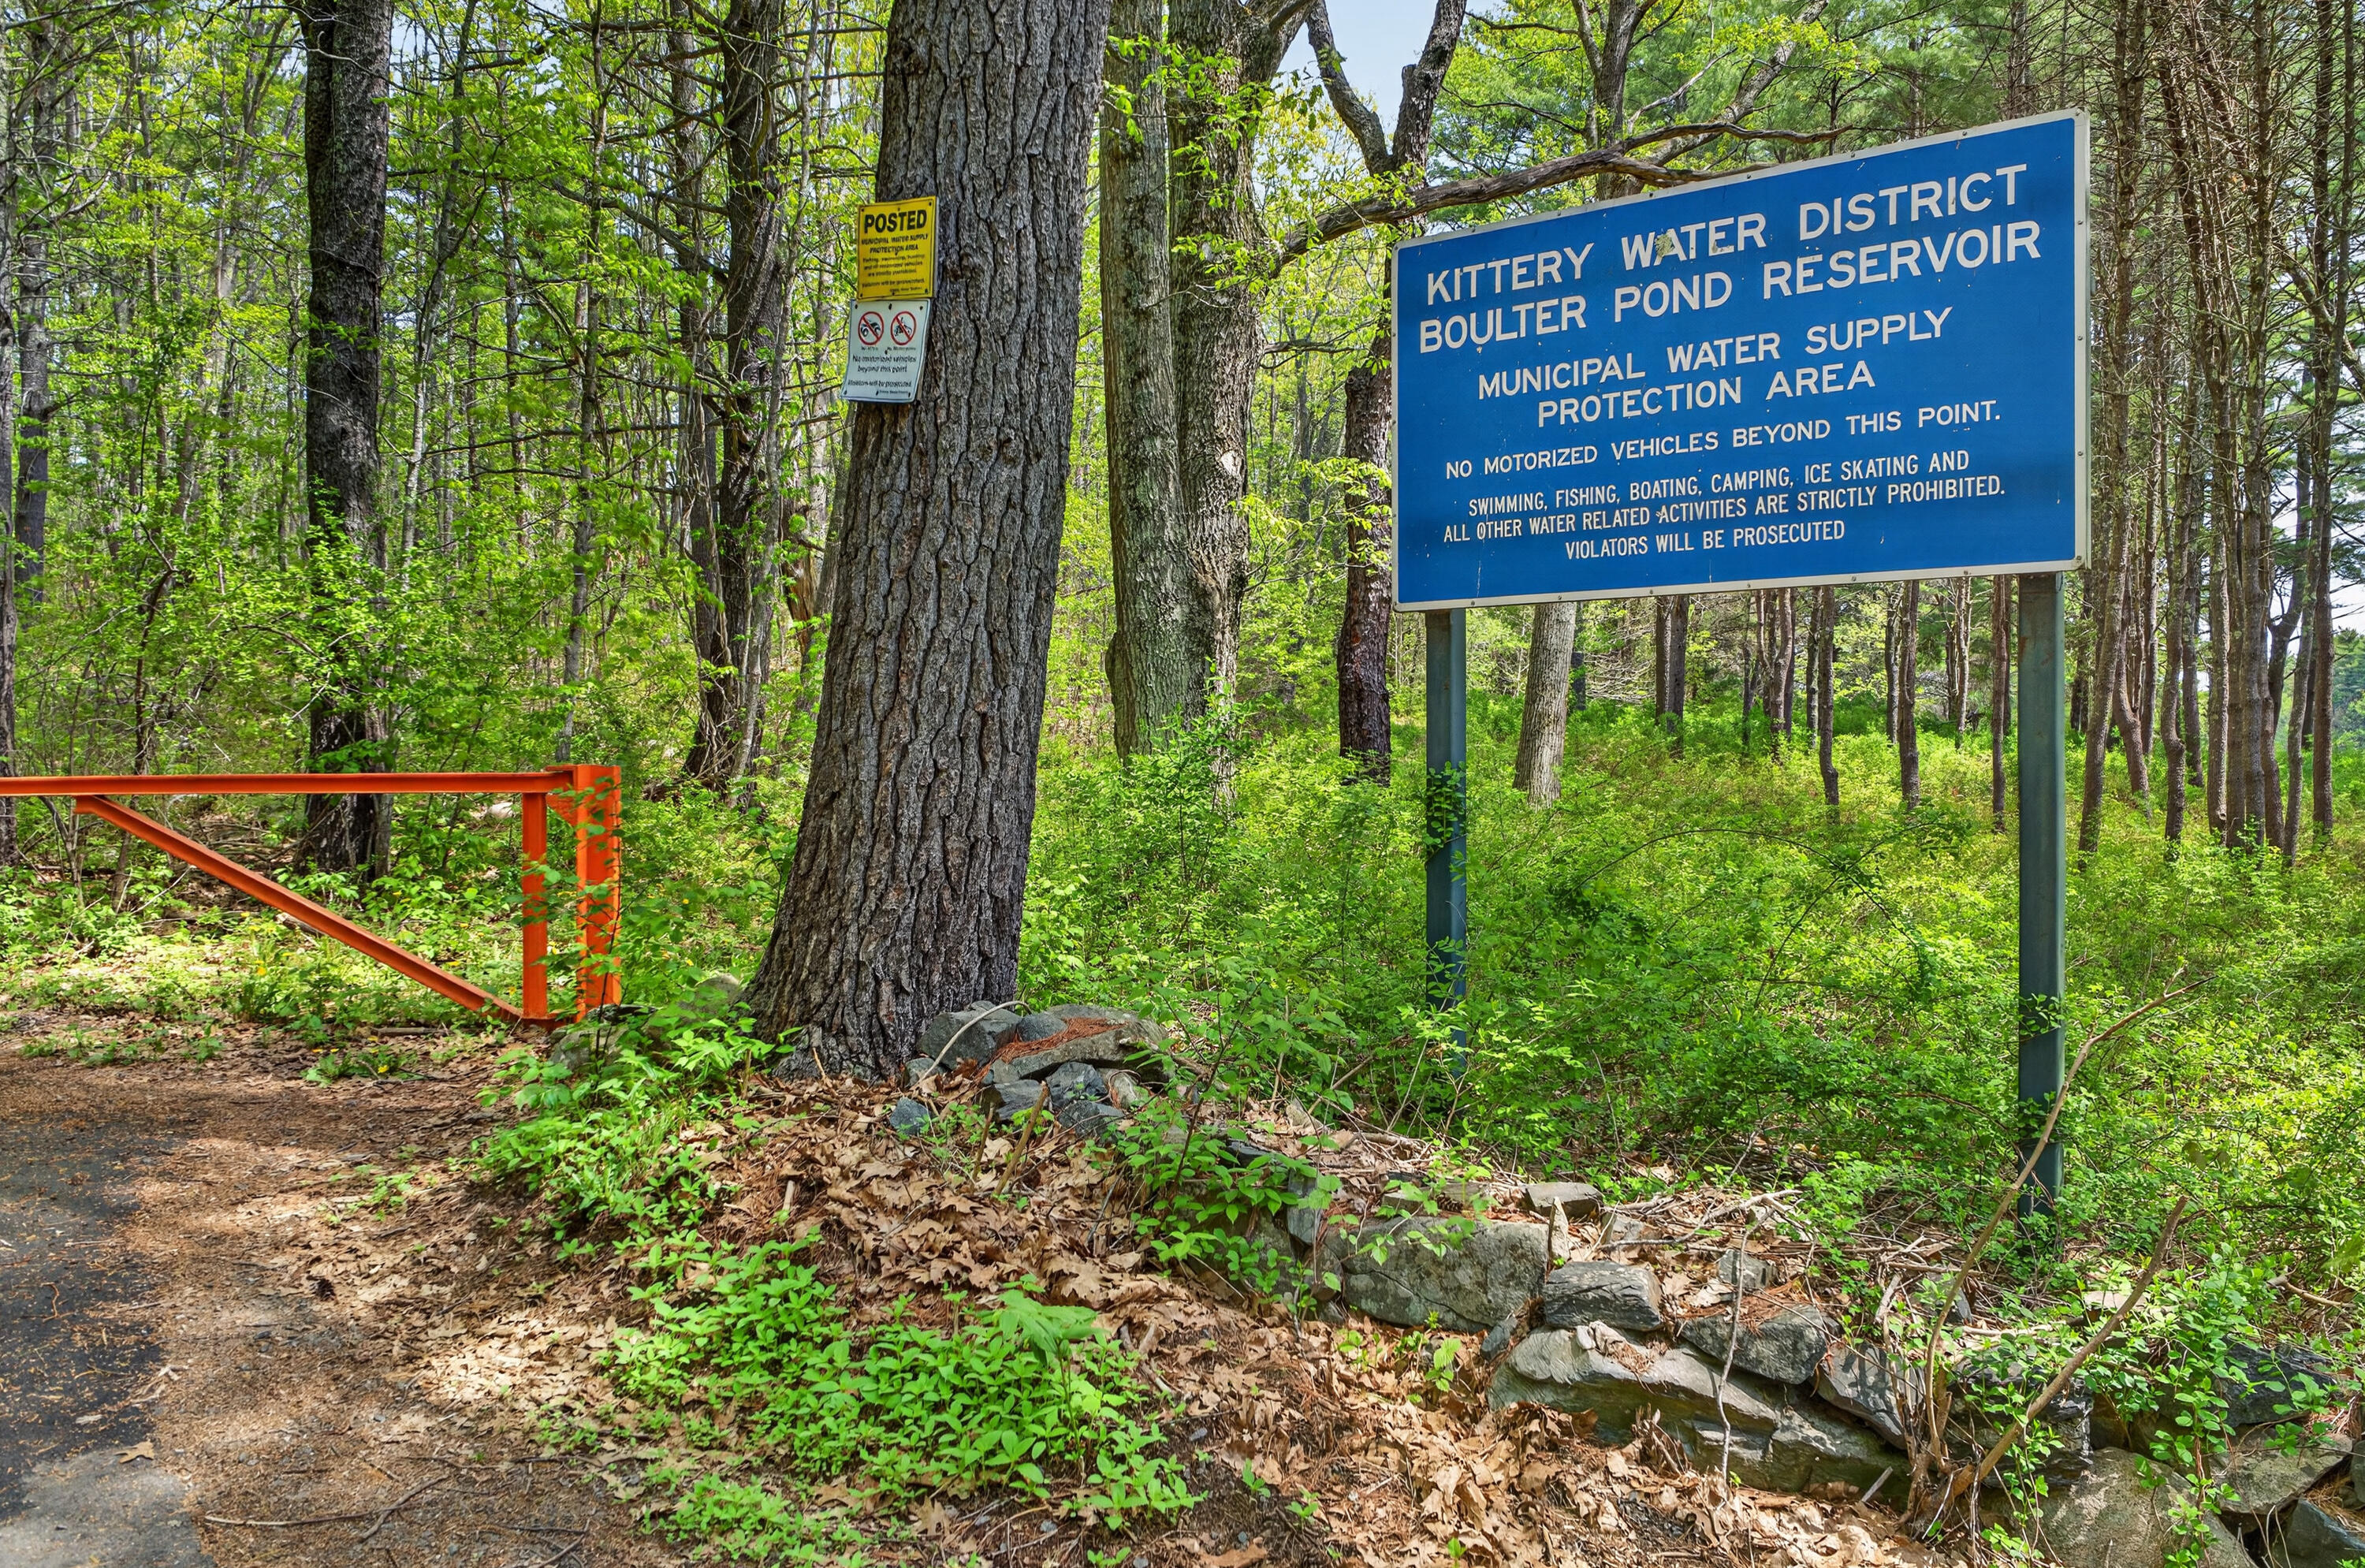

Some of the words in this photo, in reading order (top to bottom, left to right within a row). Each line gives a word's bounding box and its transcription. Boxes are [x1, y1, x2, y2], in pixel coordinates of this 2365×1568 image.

[864, 210, 927, 233] POSTED
[1428, 243, 1594, 305] KITTERY
[1622, 214, 1766, 270] WATER
[1800, 164, 2026, 240] DISTRICT
[1421, 296, 1586, 353] BOULTER
[1615, 272, 1732, 322] POND
[1764, 220, 2040, 299] RESERVOIR
[1480, 353, 1645, 399] MUNICIPAL
[1667, 333, 1780, 372] WATER
[1805, 307, 1952, 354] SUPPLY
[1539, 376, 1741, 427] PROTECTION
[1766, 360, 1875, 400] AREA
[1447, 460, 1472, 479] NO
[1485, 446, 1597, 475] MOTORIZED
[1611, 432, 1718, 460] VEHICLES
[1734, 420, 1830, 447] BEYOND
[1845, 412, 1901, 434] THIS
[1919, 400, 2000, 427] POINT.
[1444, 524, 1470, 542] ALL
[1477, 520, 1521, 539] OTHER
[1529, 514, 1575, 534] WATER
[1583, 507, 1649, 530] RELATED
[1659, 498, 1746, 523] ACTIVITIES
[1755, 494, 1789, 515] ARE
[1797, 486, 1877, 511] STRICTLY
[1888, 475, 2005, 503] PROHIBITED.
[1469, 492, 1547, 516] SWIMMING,
[1556, 485, 1619, 508] FISHING,
[1630, 477, 1701, 501] BOATING,
[1711, 467, 1793, 493] CAMPING,
[1805, 463, 1831, 483] ICE
[1841, 455, 1918, 480] SKATING
[1929, 450, 1968, 472] AND
[1566, 536, 1648, 559] VIOLATORS
[1656, 533, 1694, 553] WILL
[1704, 530, 1724, 549] BE
[1734, 520, 1845, 546] PROSECUTED
